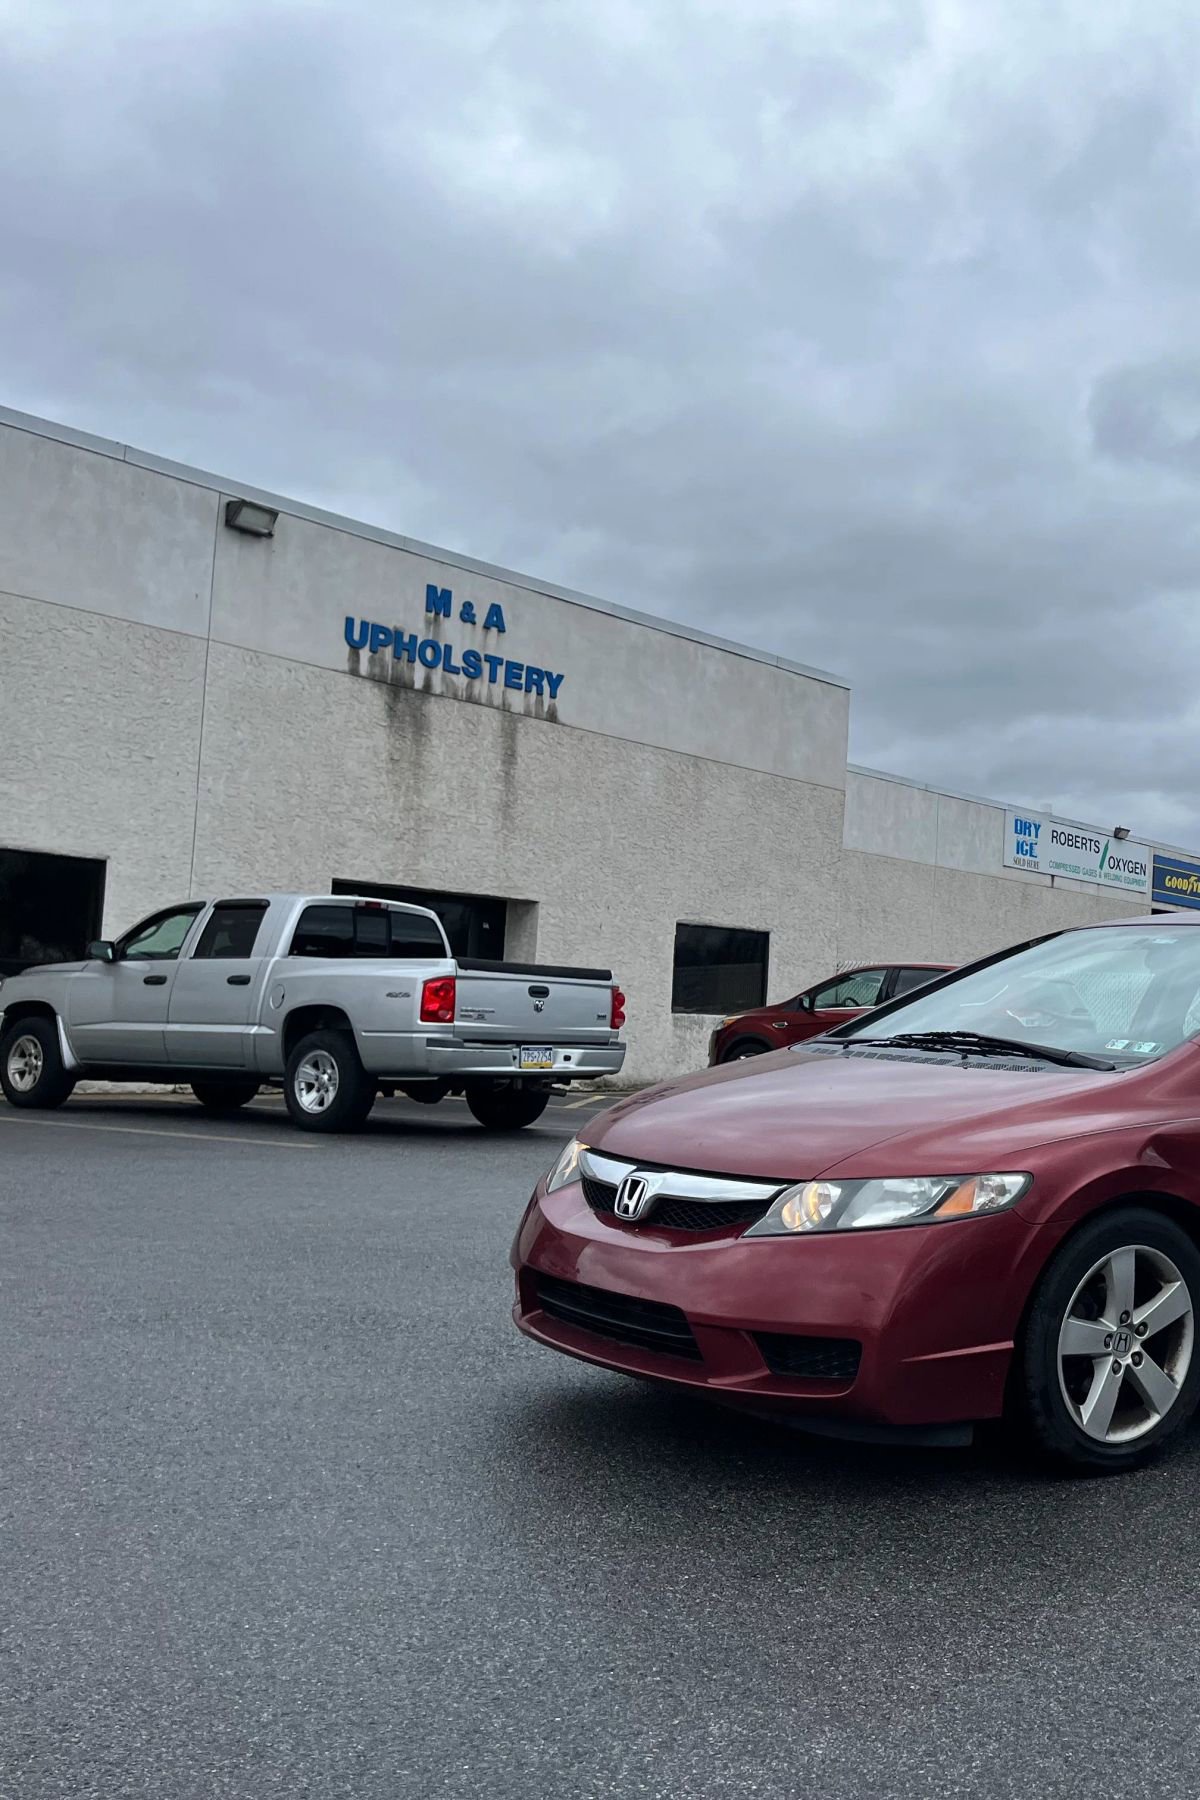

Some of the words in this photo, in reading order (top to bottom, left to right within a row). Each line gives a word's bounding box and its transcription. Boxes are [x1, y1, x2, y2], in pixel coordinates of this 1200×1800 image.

[425, 584, 452, 617] M
[459, 600, 476, 625] &
[482, 602, 506, 632] A
[344, 616, 565, 699] UPHOLSTERY
[1014, 818, 1041, 839] DRY
[1016, 840, 1038, 858] ICE
[1051, 829, 1101, 854] ROBERTS
[1027, 859, 1040, 870] HERE
[1048, 860, 1081, 875] COMPRESSED
[1108, 855, 1147, 877] OXYGEN
